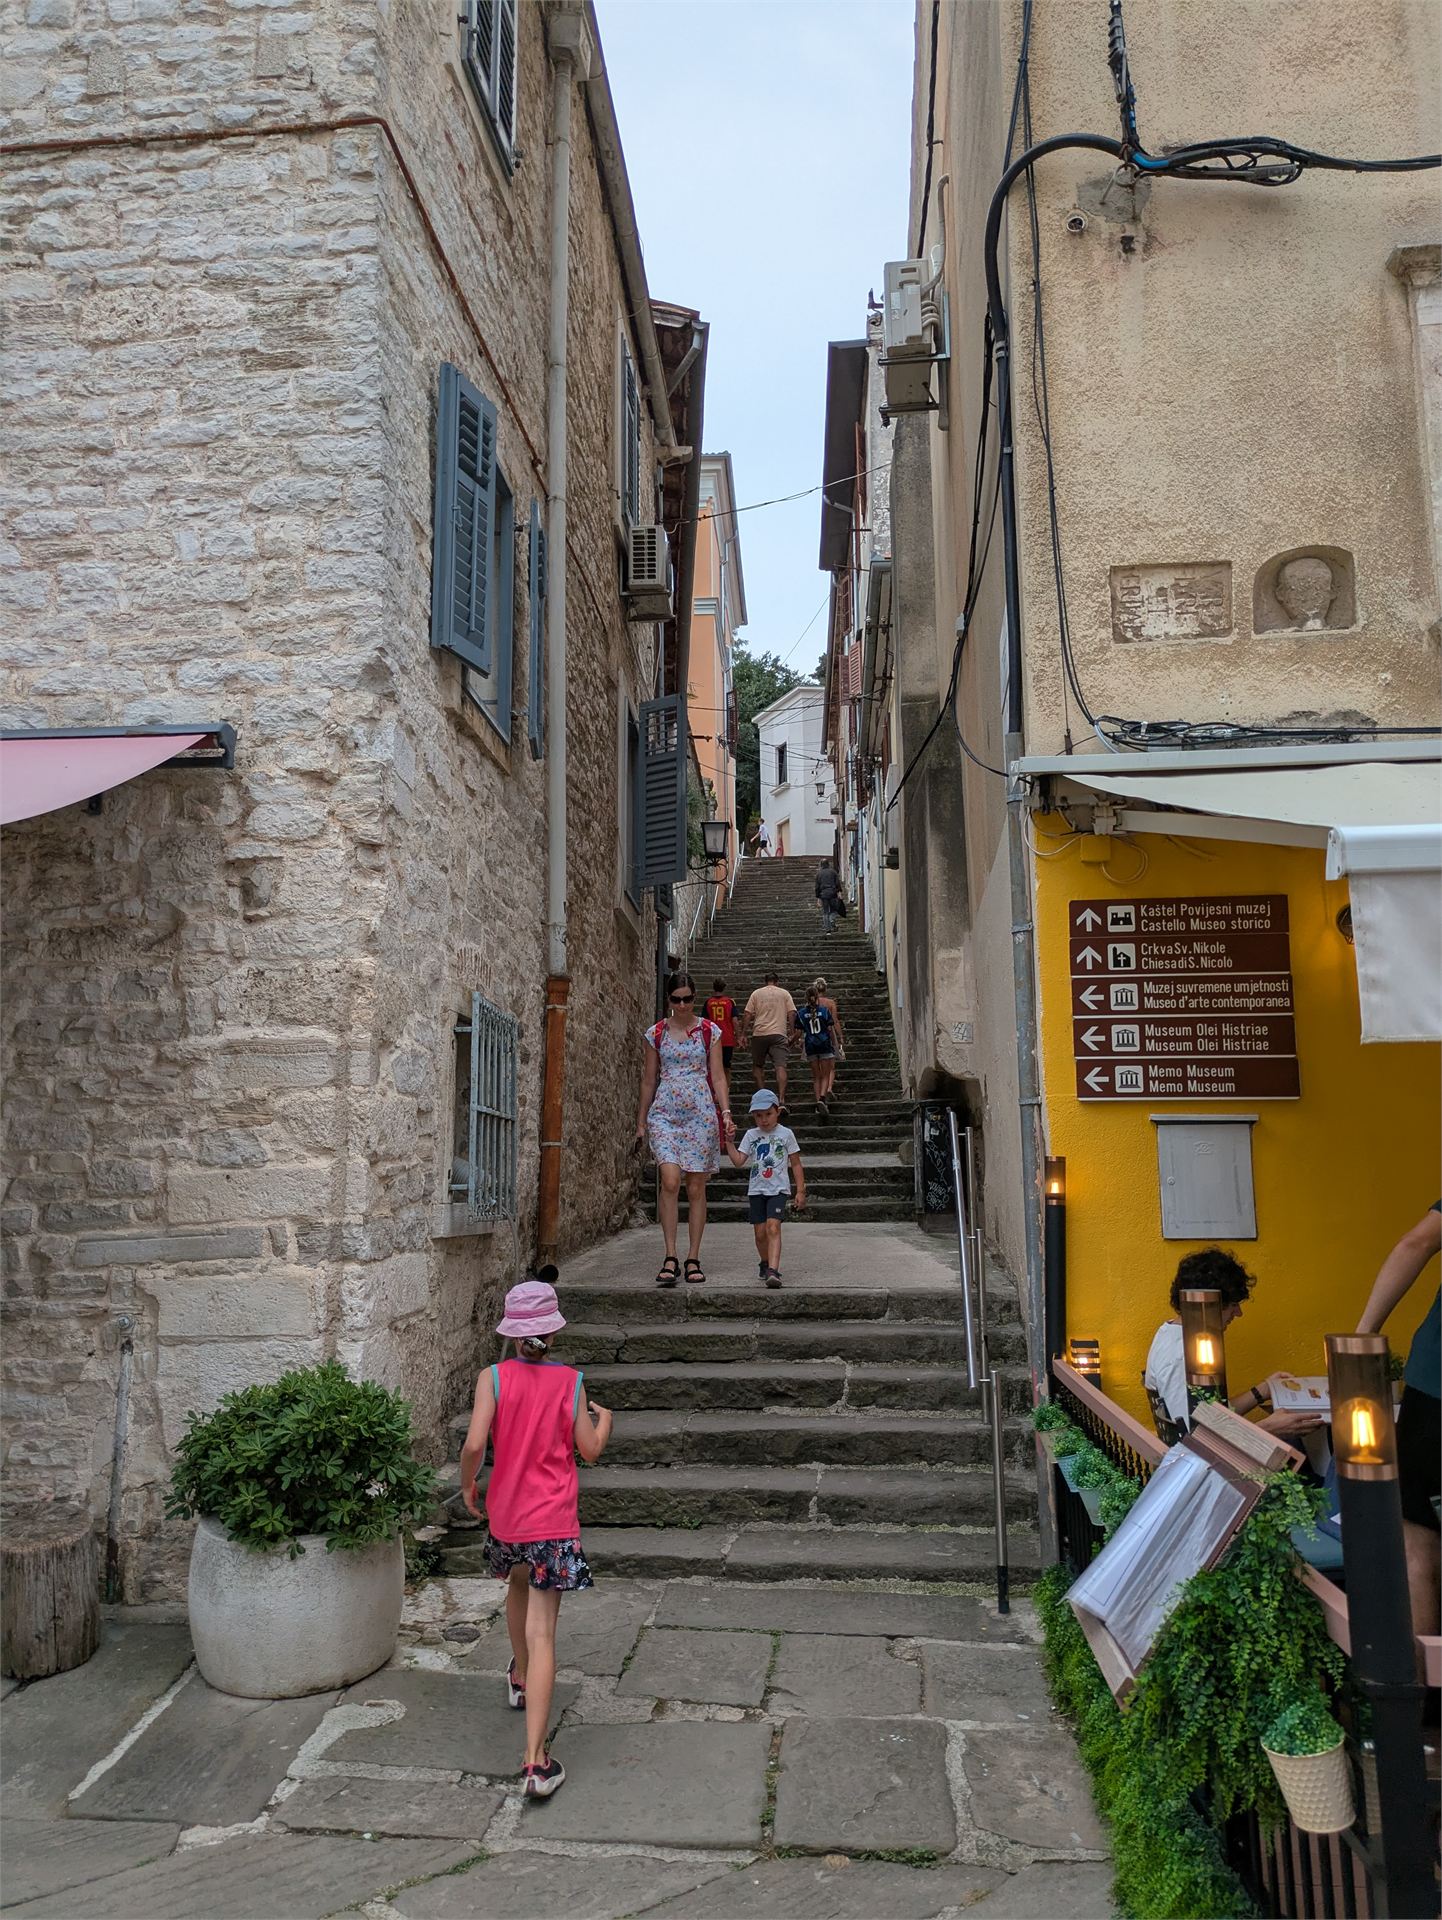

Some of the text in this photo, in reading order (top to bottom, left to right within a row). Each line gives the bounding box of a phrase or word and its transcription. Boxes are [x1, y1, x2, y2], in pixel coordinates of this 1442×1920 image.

[1140, 901, 1271, 918] Kaštel Povijesni muzej
[1141, 917, 1271, 932] Castello Museo storico
[1143, 979, 1289, 996] Muzej suvremene umjetnosti
[1144, 996, 1177, 1008] Museo
[1211, 995, 1290, 1010] contemporanea
[711, 1006, 724, 1021] 19
[809, 1018, 821, 1034] 10
[1145, 1023, 1269, 1036] Museum Olei Histriae
[1145, 1038, 1270, 1051] Museum Olei Histriae
[1148, 1064, 1235, 1077] Memo Museum
[1149, 1079, 1236, 1092] Memo Museum
